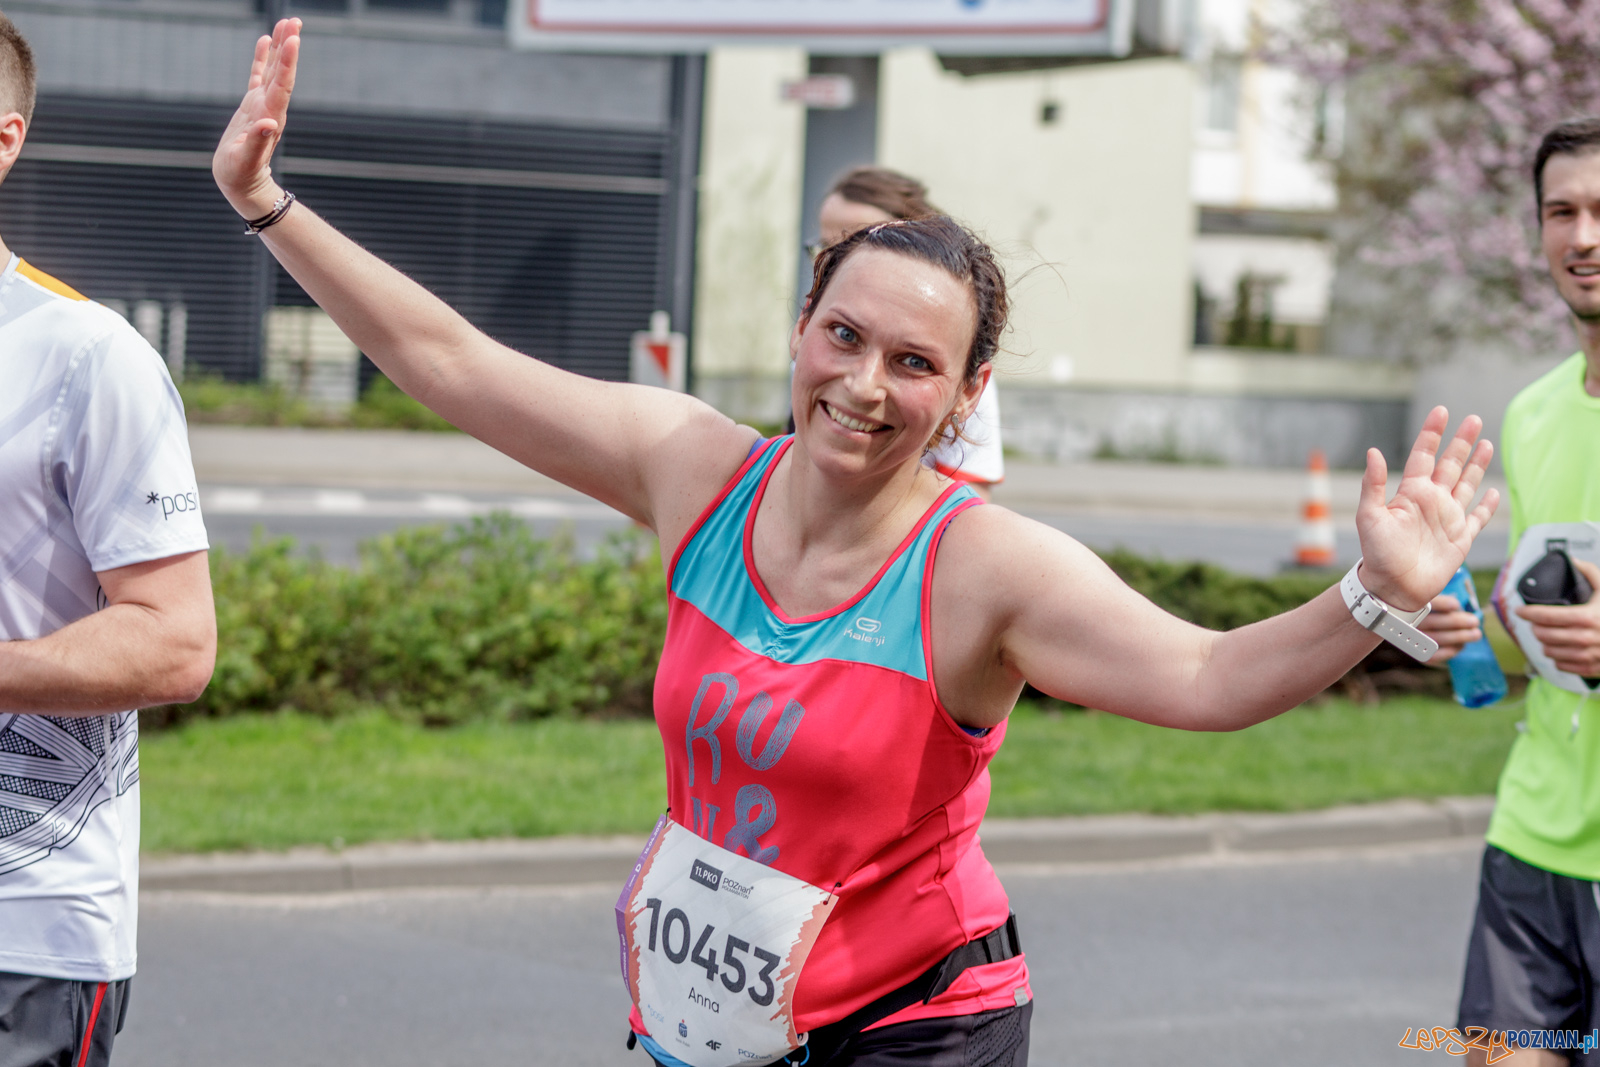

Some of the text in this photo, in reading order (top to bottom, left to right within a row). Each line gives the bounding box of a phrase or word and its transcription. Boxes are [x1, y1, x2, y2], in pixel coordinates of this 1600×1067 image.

[843, 627, 885, 647] Kalenji
[646, 897, 781, 1007] 10453
[688, 986, 720, 1014] Anna
[705, 1039, 722, 1051] 4F
